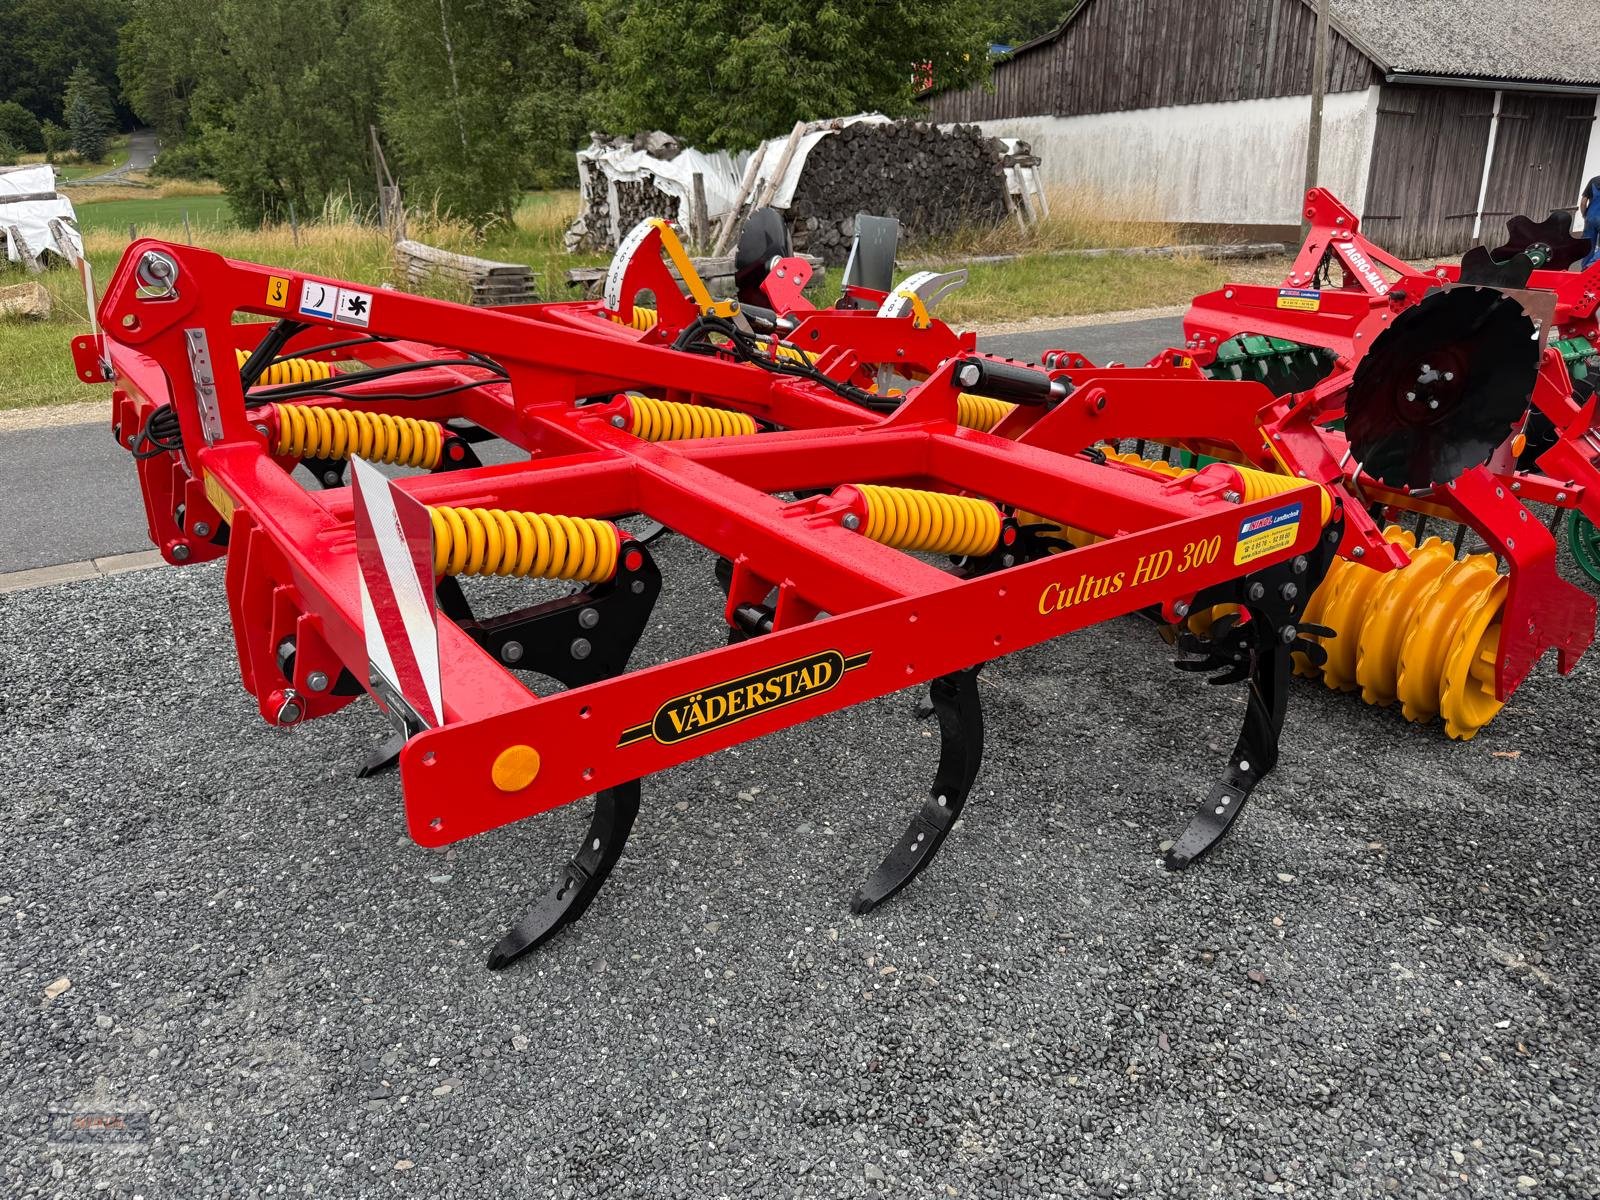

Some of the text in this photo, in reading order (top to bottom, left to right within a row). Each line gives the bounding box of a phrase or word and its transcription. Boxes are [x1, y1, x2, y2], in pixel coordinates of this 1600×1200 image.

[612, 272, 619, 283] 8
[608, 294, 616, 306] 10
[1273, 510, 1299, 523] Landtechnik
[1038, 534, 1222, 615] Cultus HD 300
[667, 661, 832, 734] VÄDERSTAD
